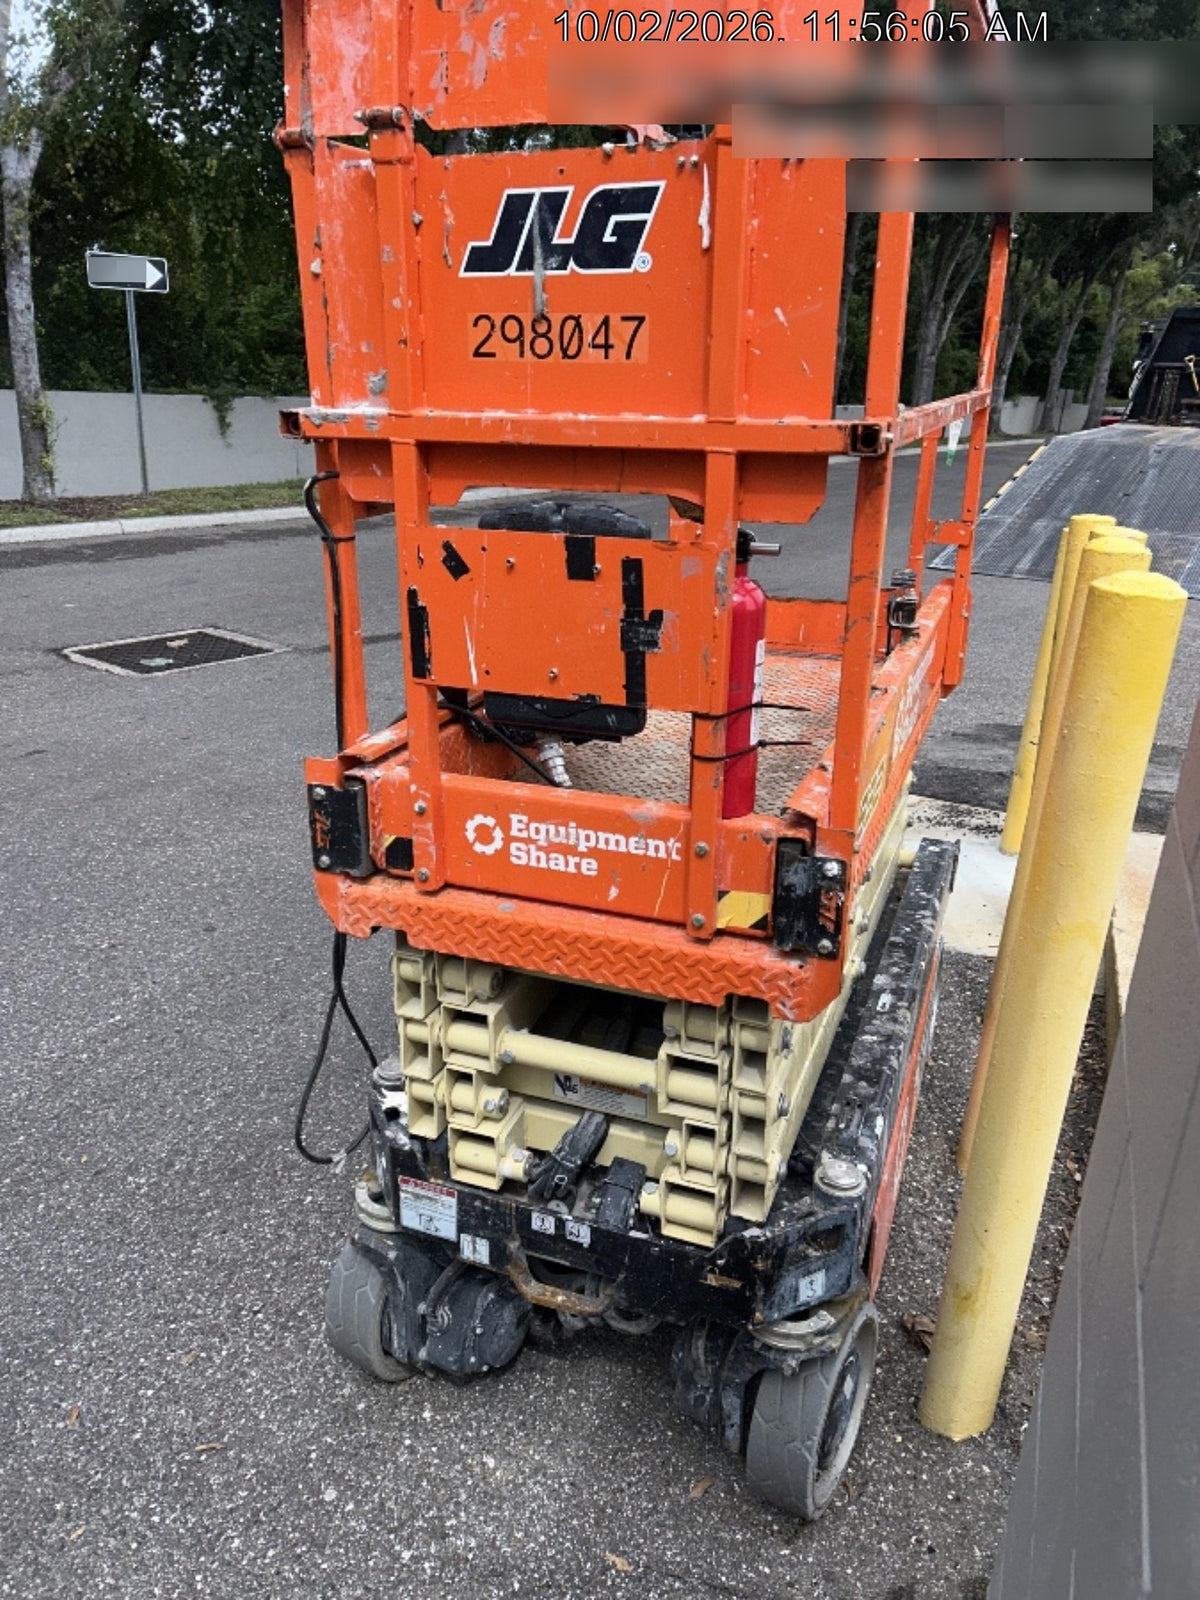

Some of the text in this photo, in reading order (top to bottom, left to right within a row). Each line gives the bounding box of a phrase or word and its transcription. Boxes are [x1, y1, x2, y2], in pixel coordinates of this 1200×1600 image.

[458, 180, 667, 277] JLG
[472, 314, 646, 361] 298047
[509, 812, 682, 861] Equipment
[509, 842, 598, 876] Share
